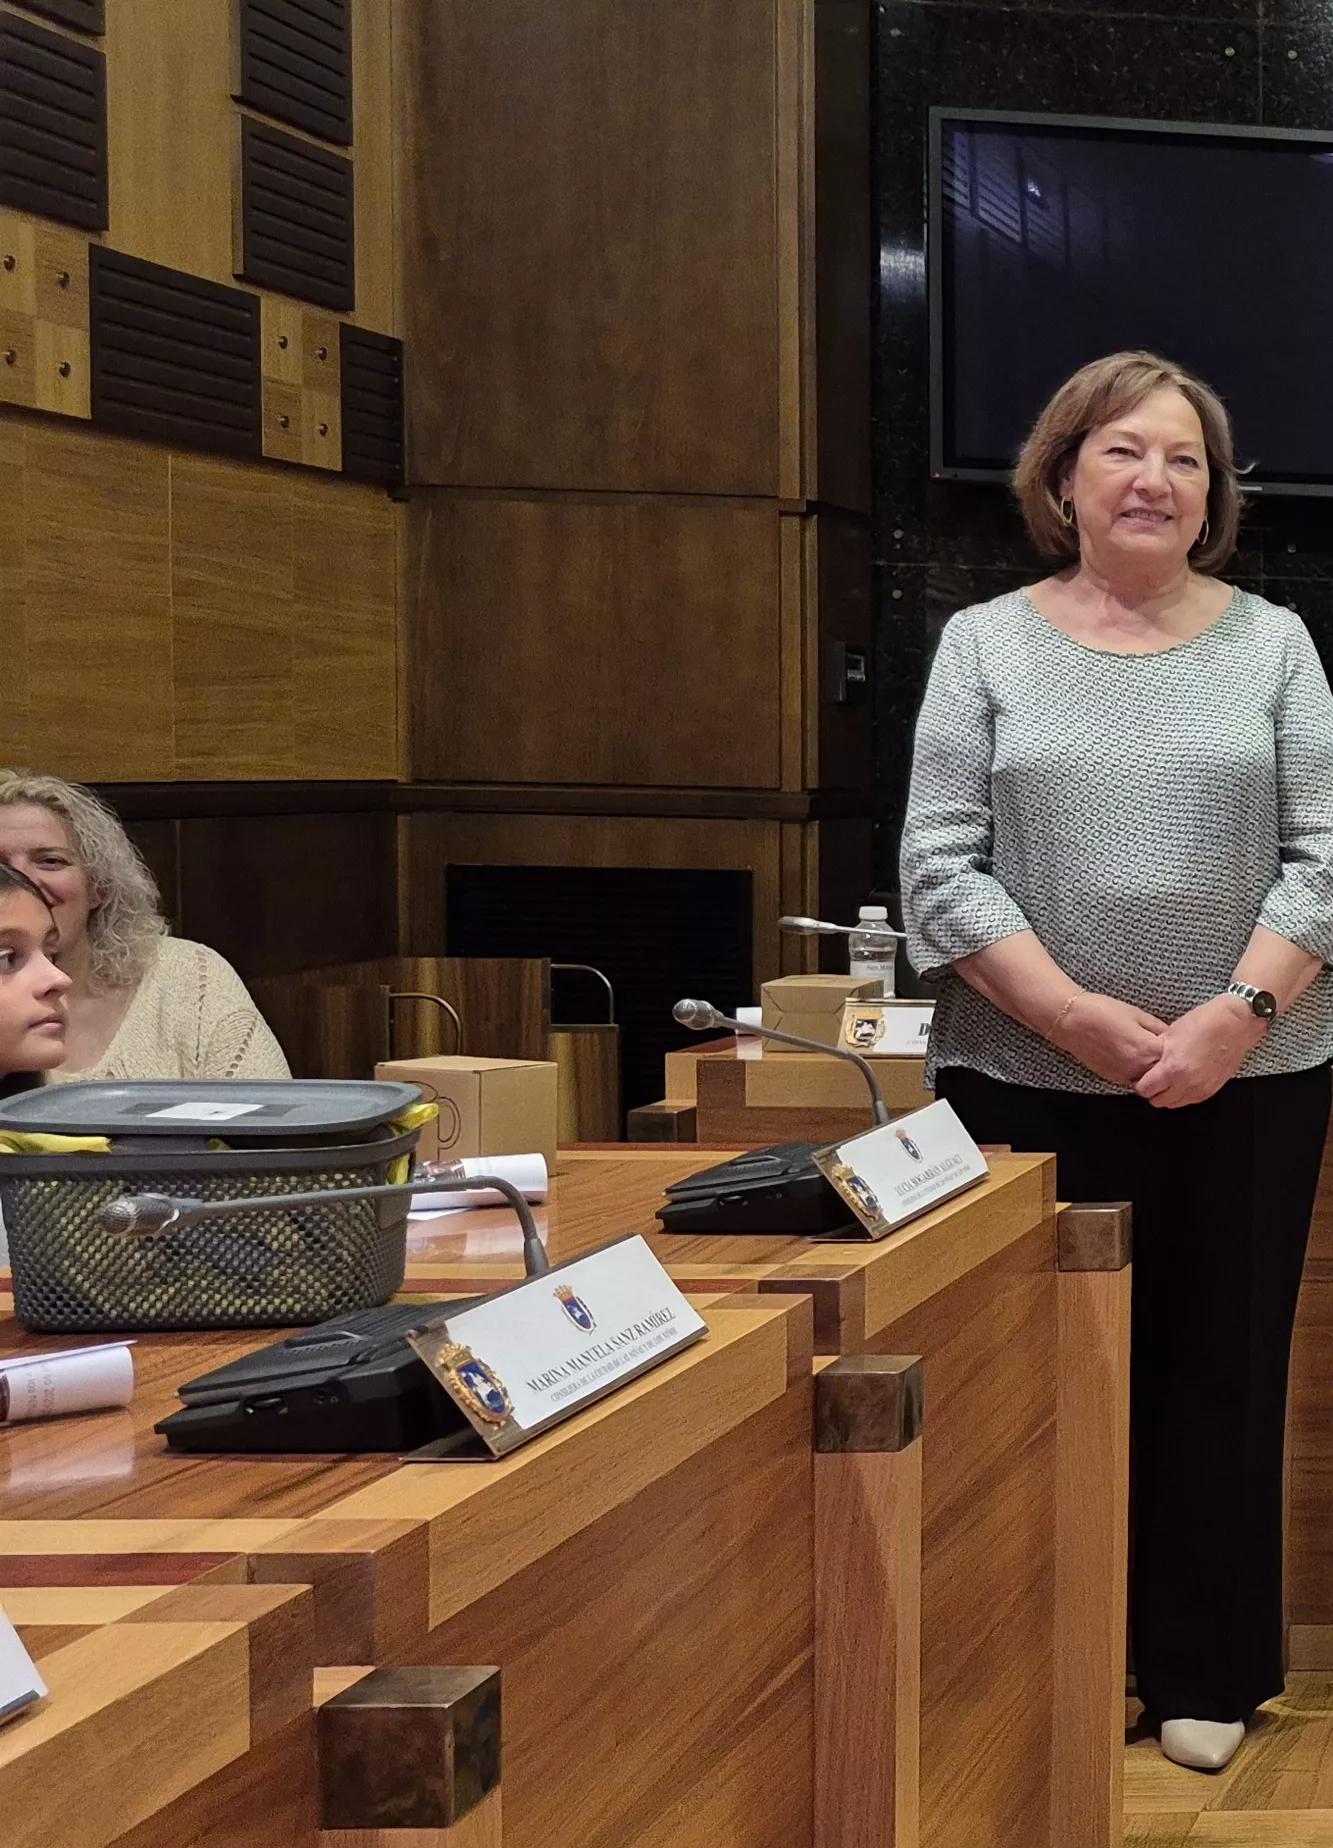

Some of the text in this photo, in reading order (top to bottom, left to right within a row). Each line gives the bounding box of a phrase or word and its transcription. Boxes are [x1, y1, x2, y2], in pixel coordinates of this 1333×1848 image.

[526, 1365, 571, 1395] MARINA
[565, 1341, 616, 1374] MANUELA
[609, 1327, 638, 1350] SANZ
